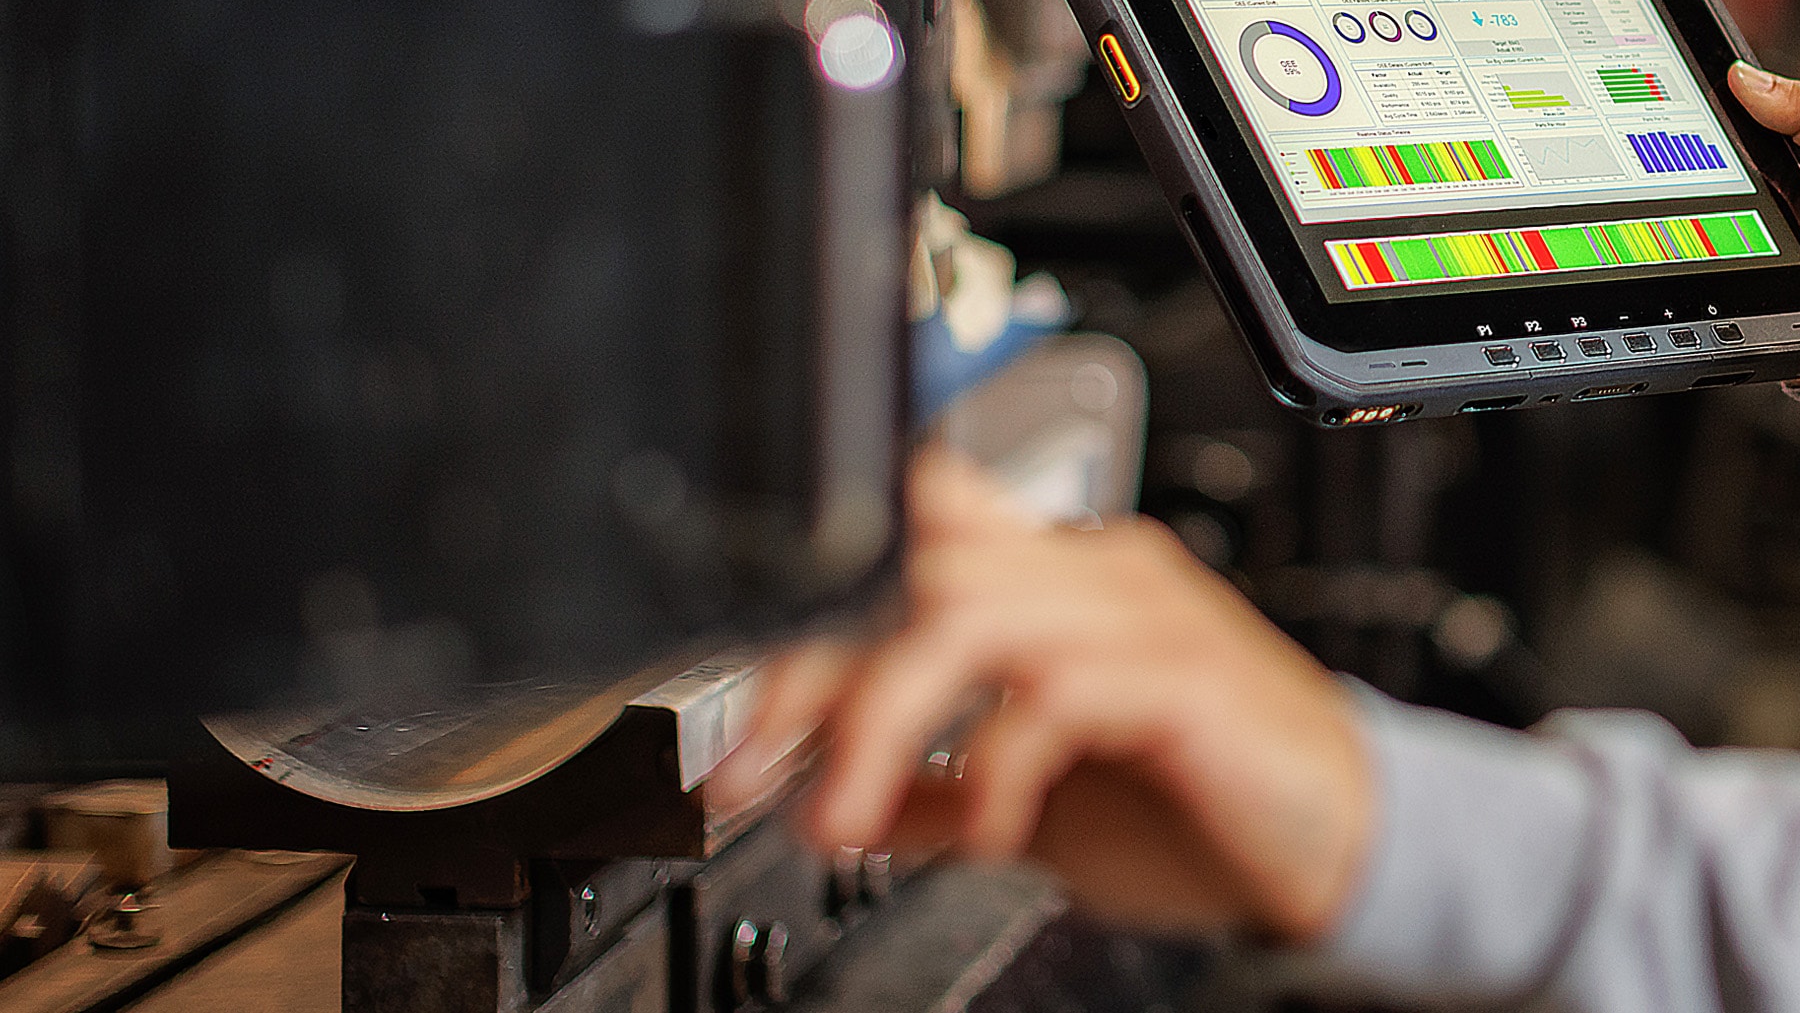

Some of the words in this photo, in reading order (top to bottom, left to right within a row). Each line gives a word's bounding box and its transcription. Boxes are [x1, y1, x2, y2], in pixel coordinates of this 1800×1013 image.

[1489, 14, 1518, 27] -783
[1280, 60, 1298, 68] OEE
[1477, 325, 1493, 336] P1
[1525, 320, 1542, 332] P2
[1571, 316, 1588, 328] P3
